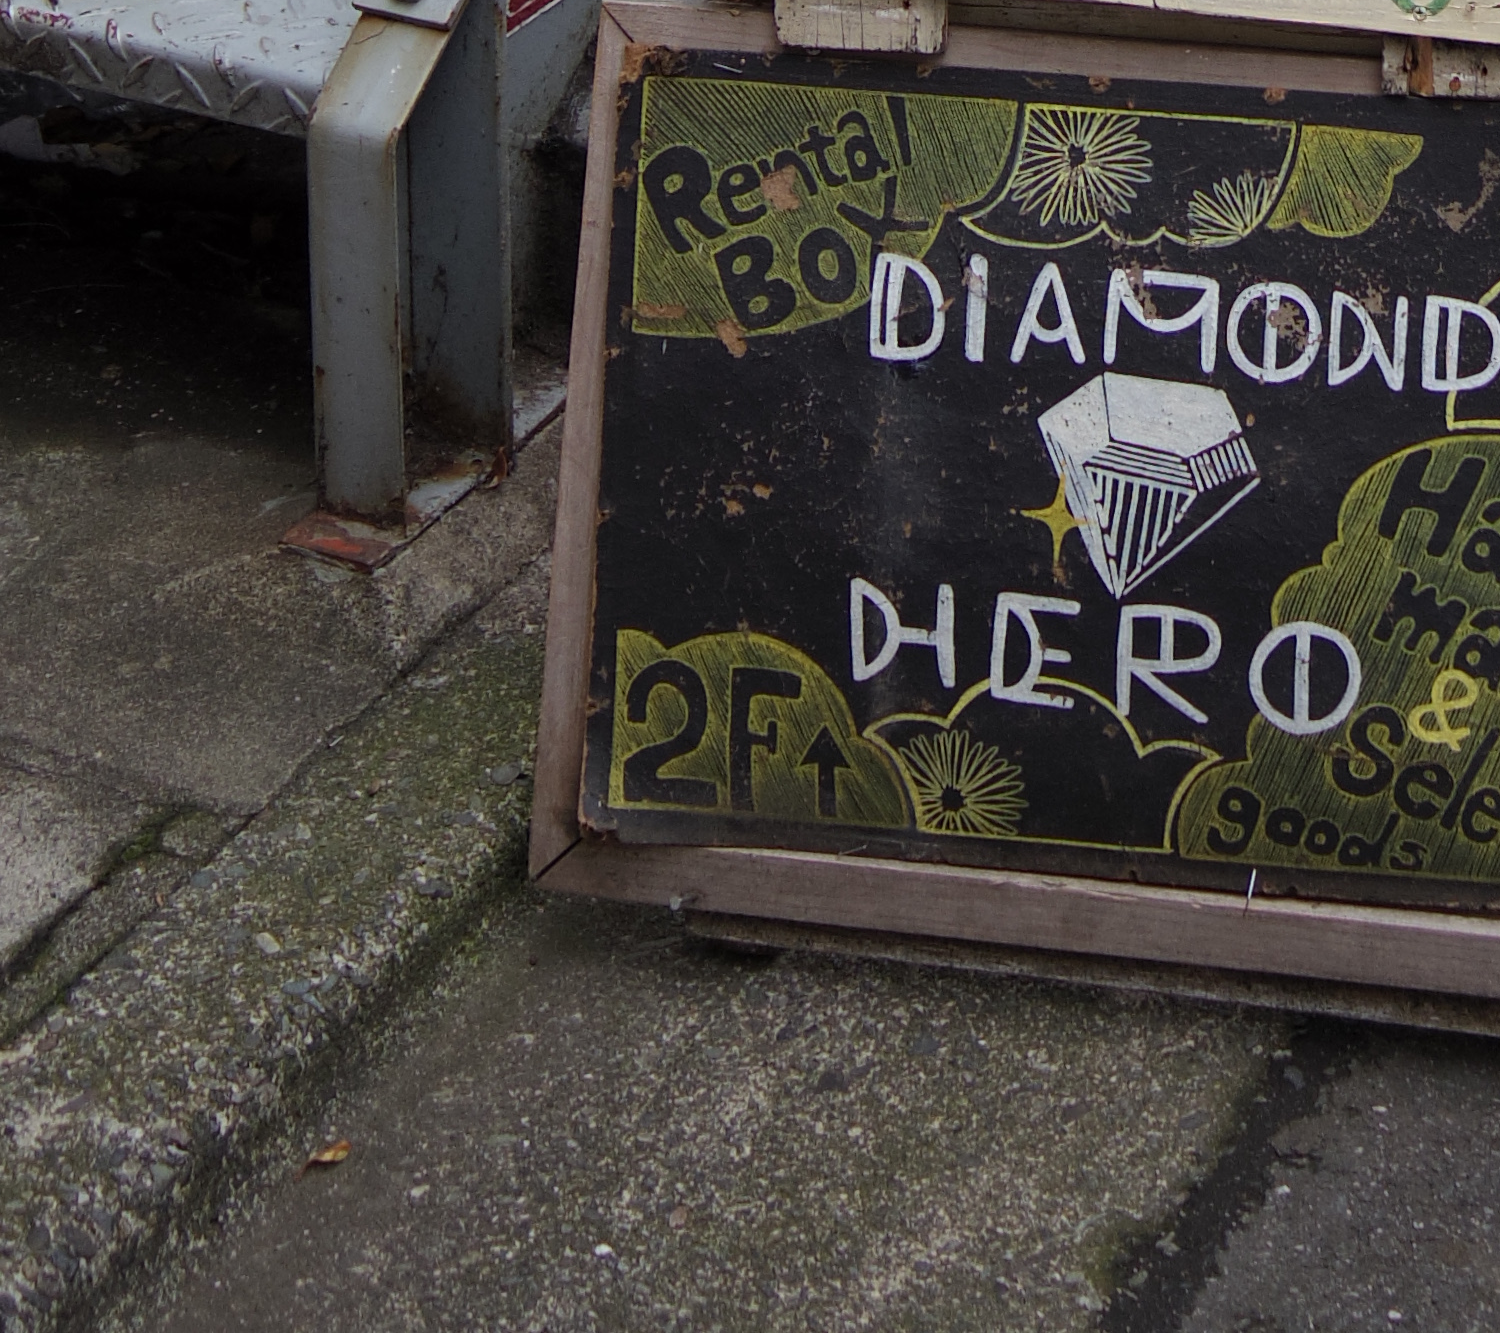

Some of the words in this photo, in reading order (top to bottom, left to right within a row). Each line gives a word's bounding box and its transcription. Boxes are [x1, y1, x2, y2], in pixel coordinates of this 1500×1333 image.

[642, 95, 911, 255] Rental
[620, 656, 803, 813] 2F
[1406, 667, 1482, 754] &
[1206, 783, 1428, 874] goods
